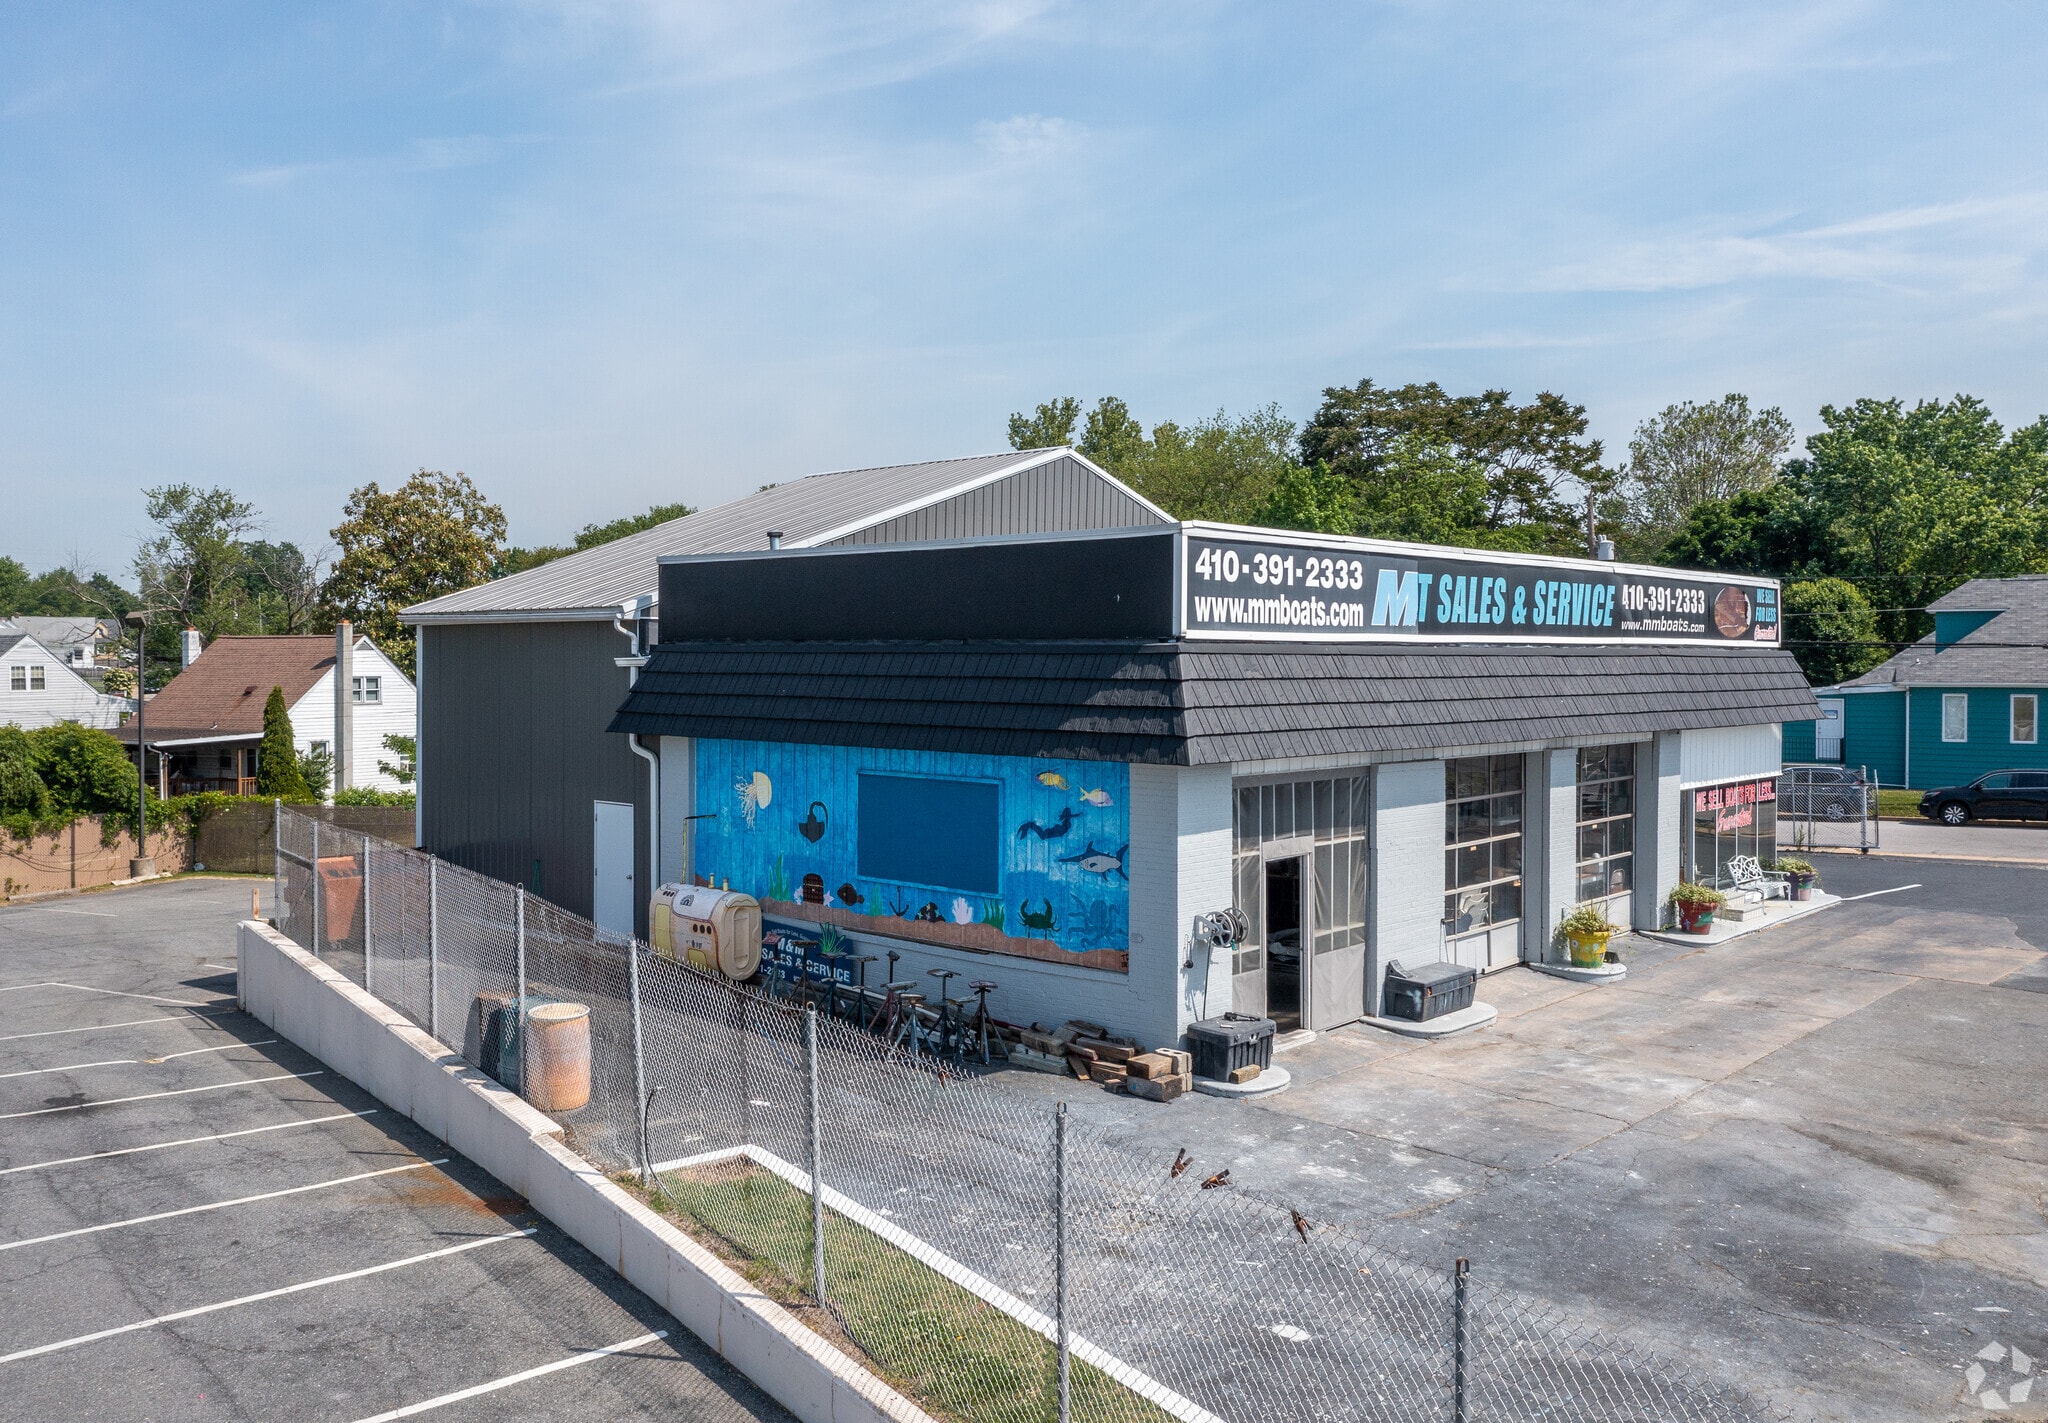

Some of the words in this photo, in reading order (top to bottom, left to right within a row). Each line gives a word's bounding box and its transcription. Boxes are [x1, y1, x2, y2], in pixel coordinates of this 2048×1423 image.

[1195, 548, 1364, 591] 410-391-2333
[1195, 594, 1364, 627] www.mmboats.com
[1437, 574, 1507, 624] SALES
[1512, 585, 1527, 625] &
[1533, 580, 1616, 627] SERVICE
[1621, 584, 1706, 614] 410-391-2333
[1621, 616, 1706, 633] www.mmboats.com
[1696, 791, 1707, 812] WE
[1708, 789, 1724, 811] SELL
[1725, 785, 1745, 808] BOATS
[1745, 783, 1756, 804] FOR
[806, 959, 850, 982] SERVICE
